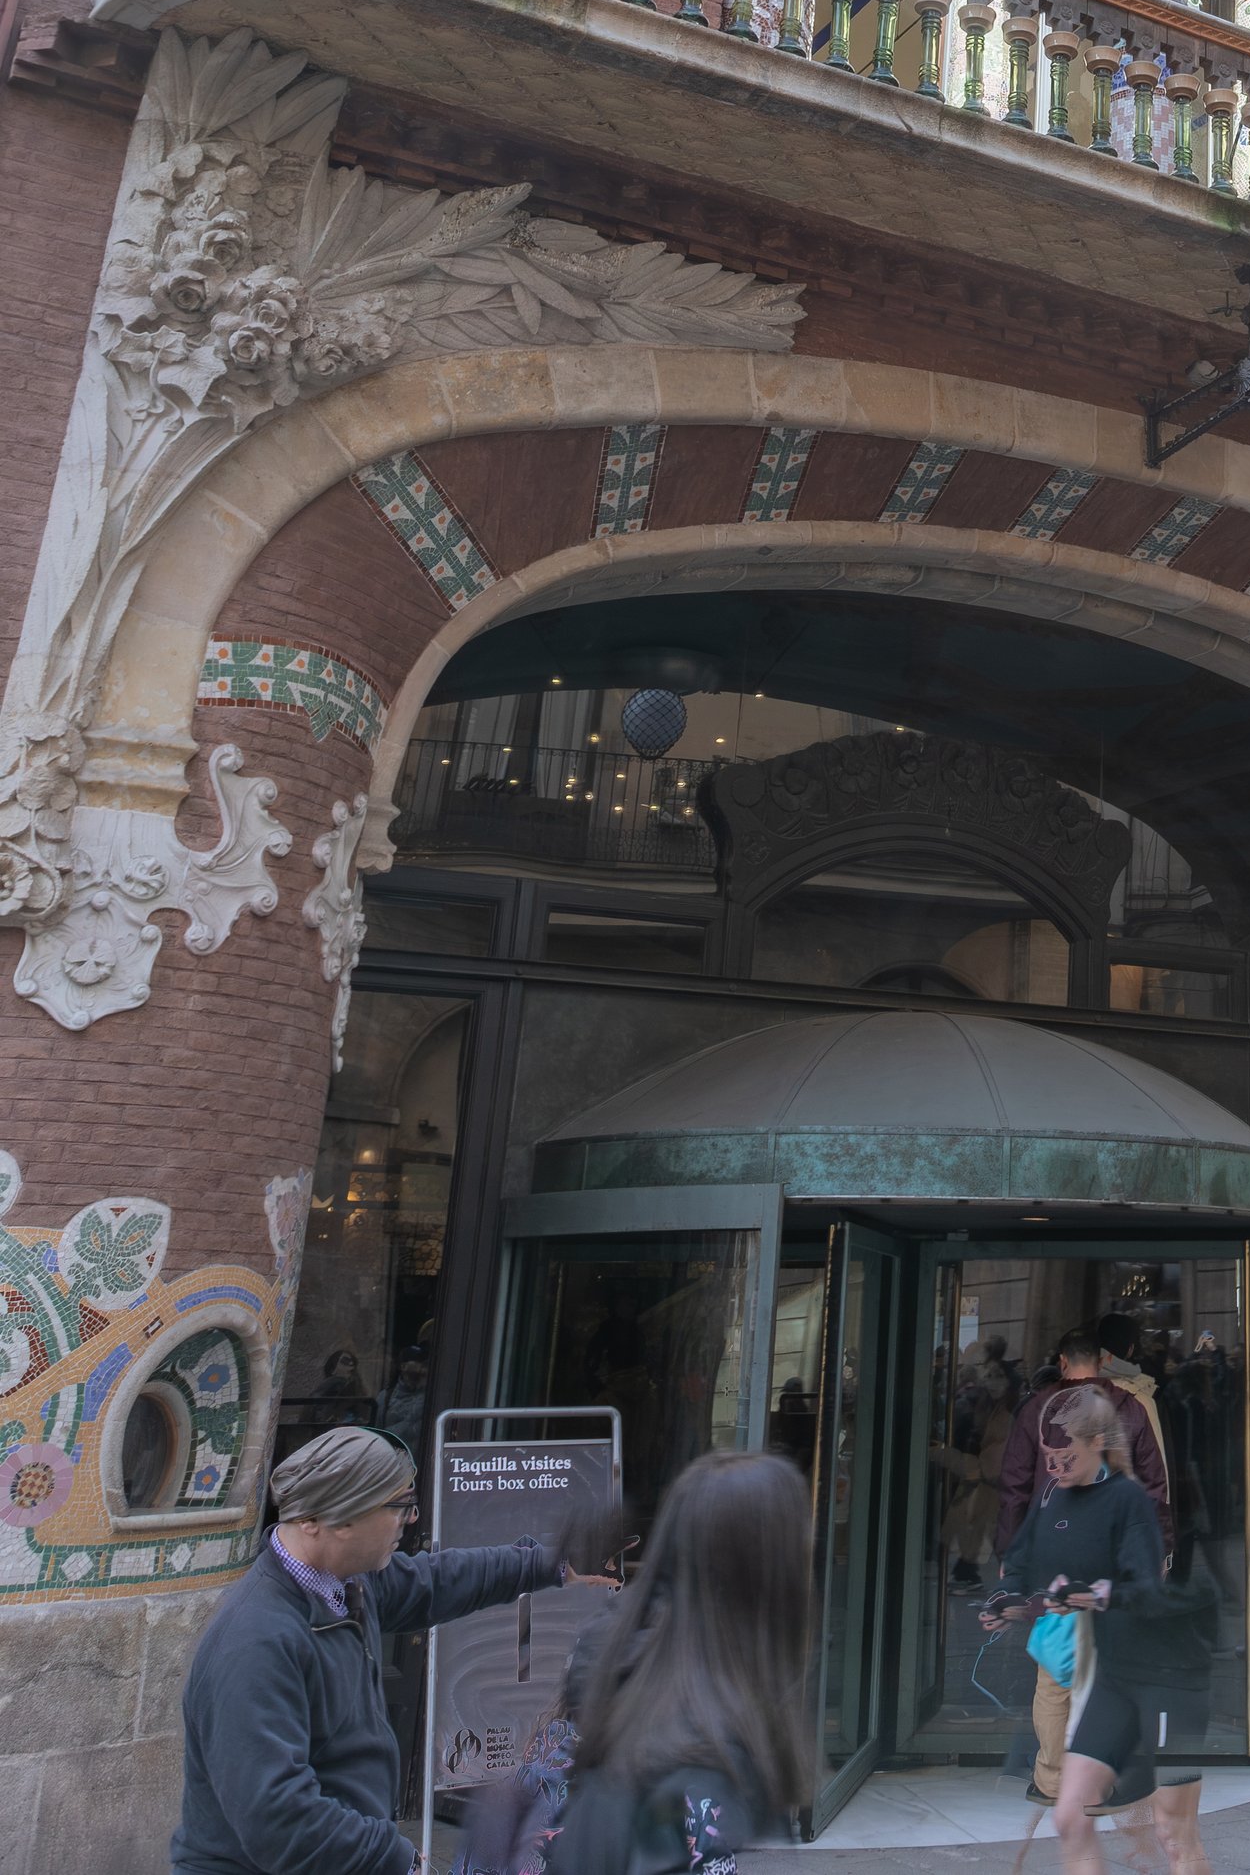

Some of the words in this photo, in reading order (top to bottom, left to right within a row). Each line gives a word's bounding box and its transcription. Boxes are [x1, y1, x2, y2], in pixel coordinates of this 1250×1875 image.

[450, 1456, 517, 1475] Taquilla
[521, 1455, 572, 1471] visites
[449, 1476, 493, 1492] Tours
[497, 1475, 525, 1490] box
[528, 1473, 569, 1488] office
[486, 1727, 511, 1735] PALAU
[486, 1736, 497, 1744] DE
[499, 1735, 509, 1743] LA
